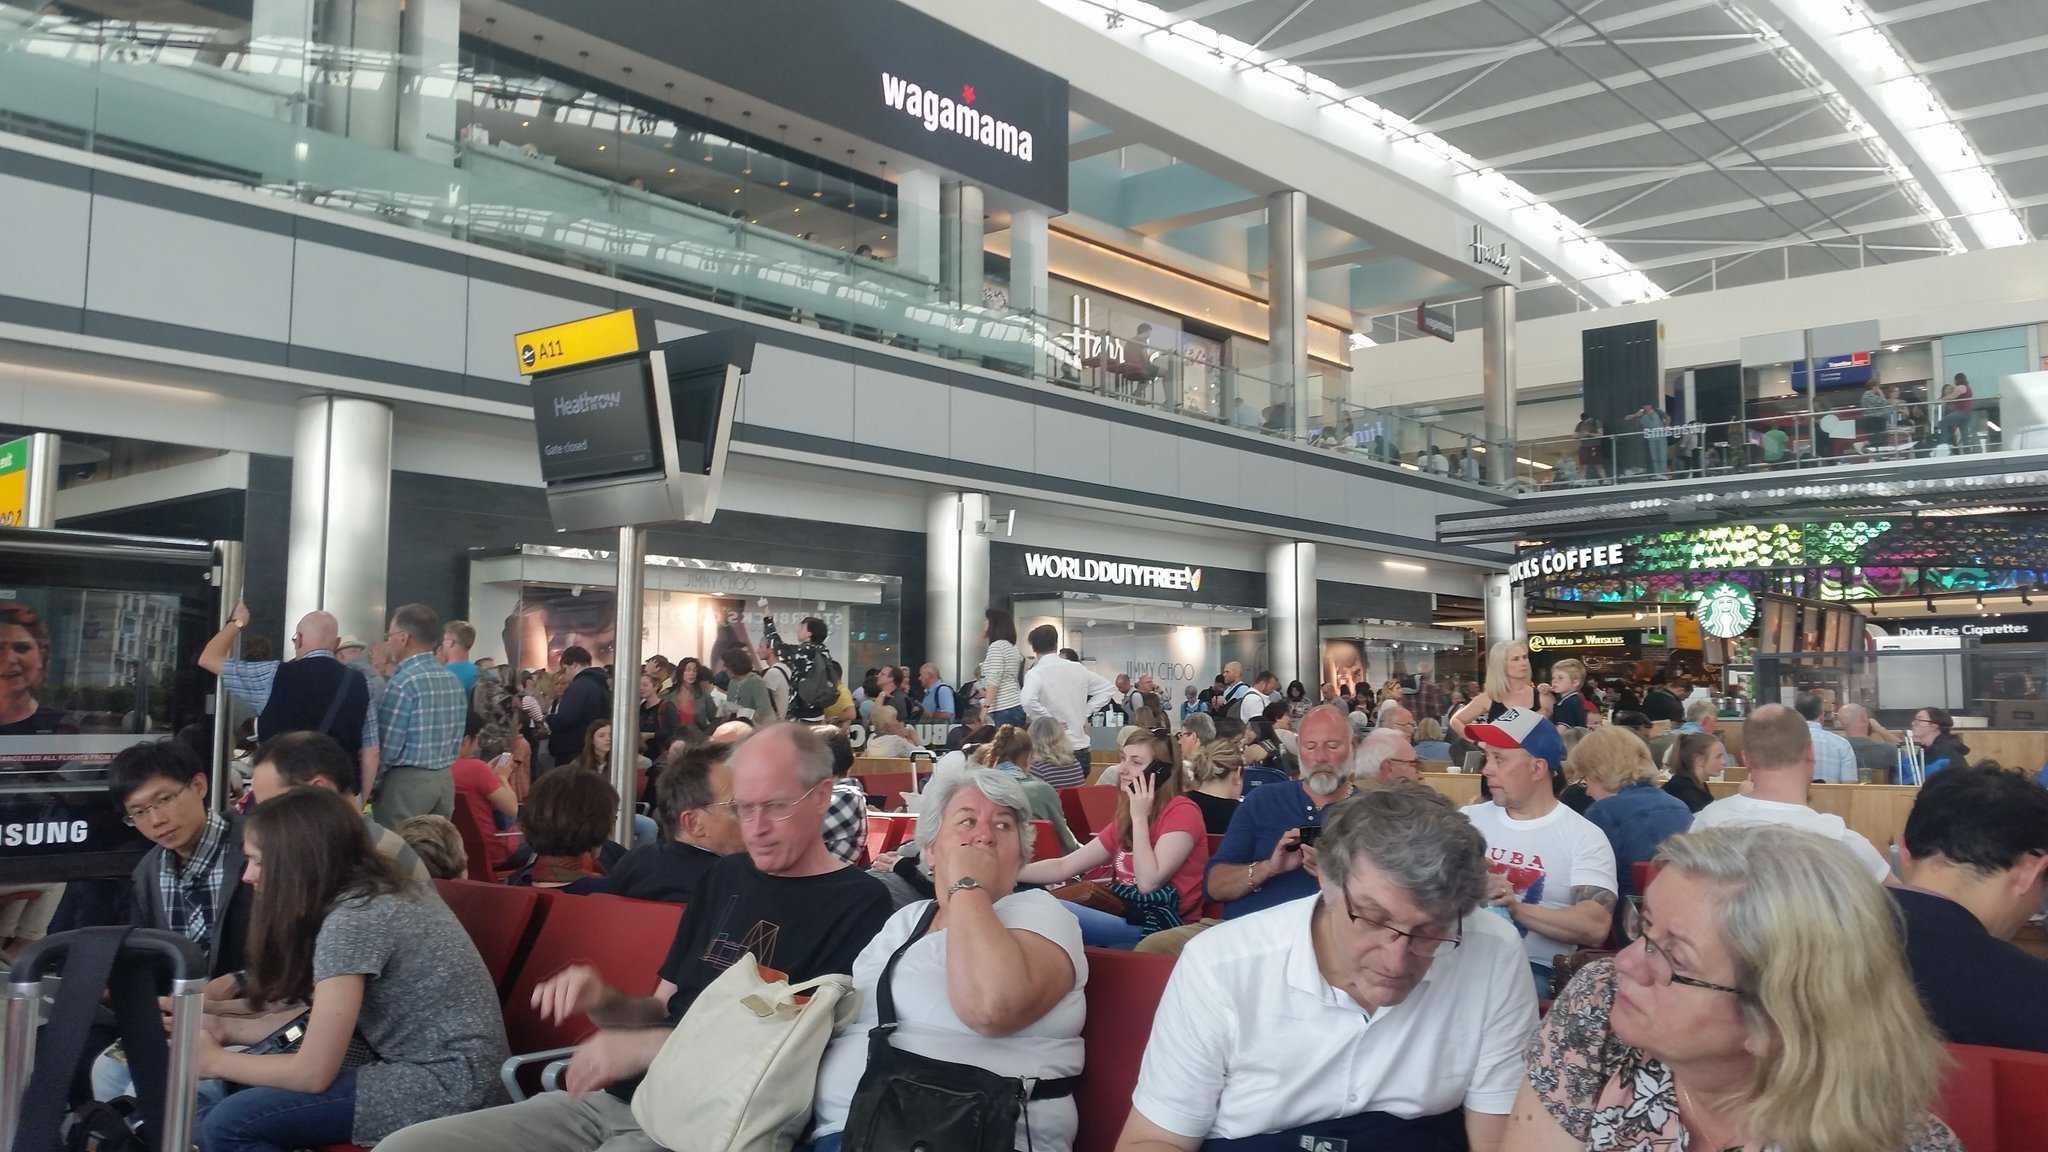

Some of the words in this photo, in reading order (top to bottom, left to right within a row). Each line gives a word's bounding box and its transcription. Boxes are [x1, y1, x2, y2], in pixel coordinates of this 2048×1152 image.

[882, 72, 1033, 162] wagamama
[539, 339, 564, 360] A11
[554, 391, 622, 416] Heathrow
[544, 443, 562, 457] Gate
[564, 439, 588, 453] closed
[1542, 543, 1623, 575] COFFEE
[1899, 627, 1928, 638] Duty
[1931, 627, 1959, 637] Free
[1961, 624, 2029, 638] Cigarettes
[1158, 662, 1194, 681] CHOO
[0, 820, 88, 846] SUNG
[1491, 848, 1545, 870] UBA
